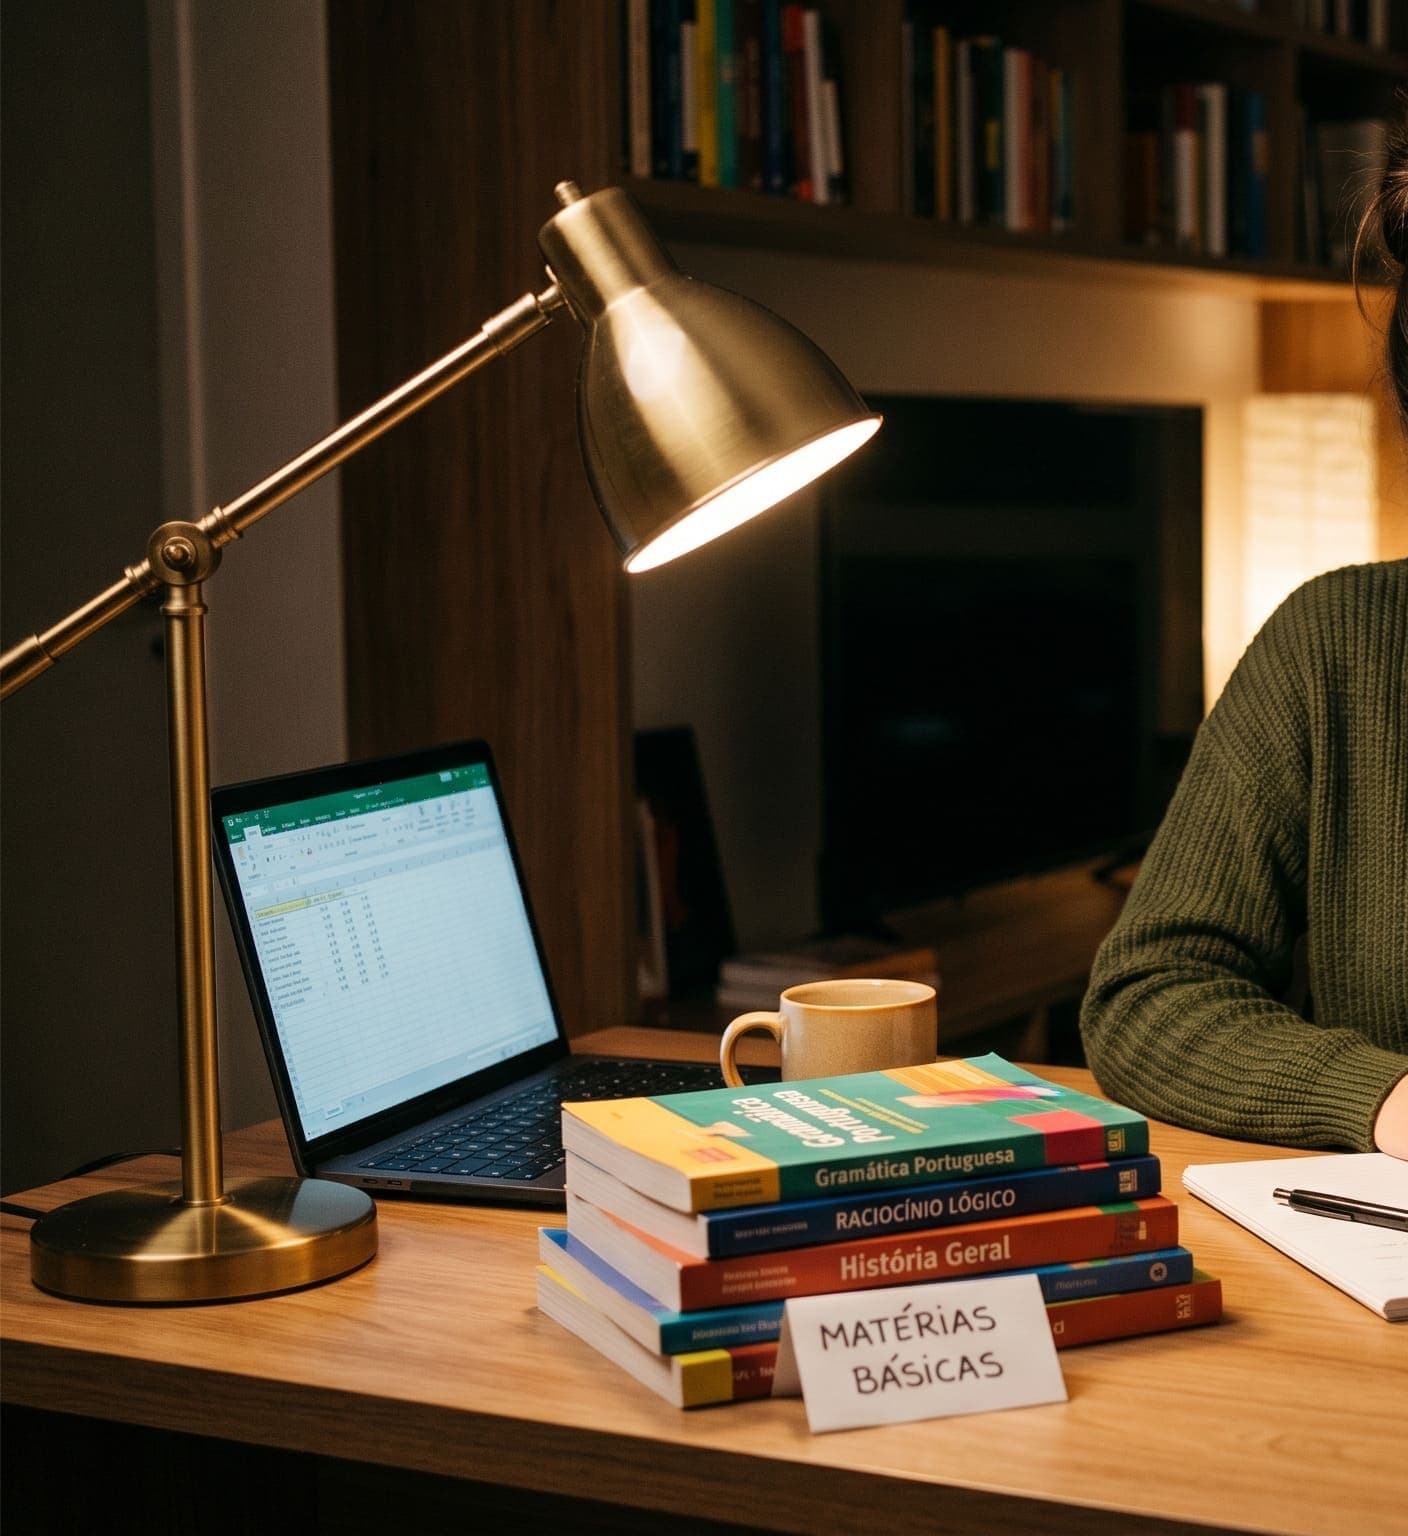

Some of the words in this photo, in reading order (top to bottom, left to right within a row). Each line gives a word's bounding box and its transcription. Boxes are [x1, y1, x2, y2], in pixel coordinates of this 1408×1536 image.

[814, 1161, 910, 1187] Gramática
[913, 1148, 1015, 1173] Portuguesa
[835, 1198, 943, 1231] RACIOCÍNIO
[948, 1188, 1016, 1214] LÓGICO
[840, 1245, 938, 1281] História
[944, 1234, 1012, 1267] Geral
